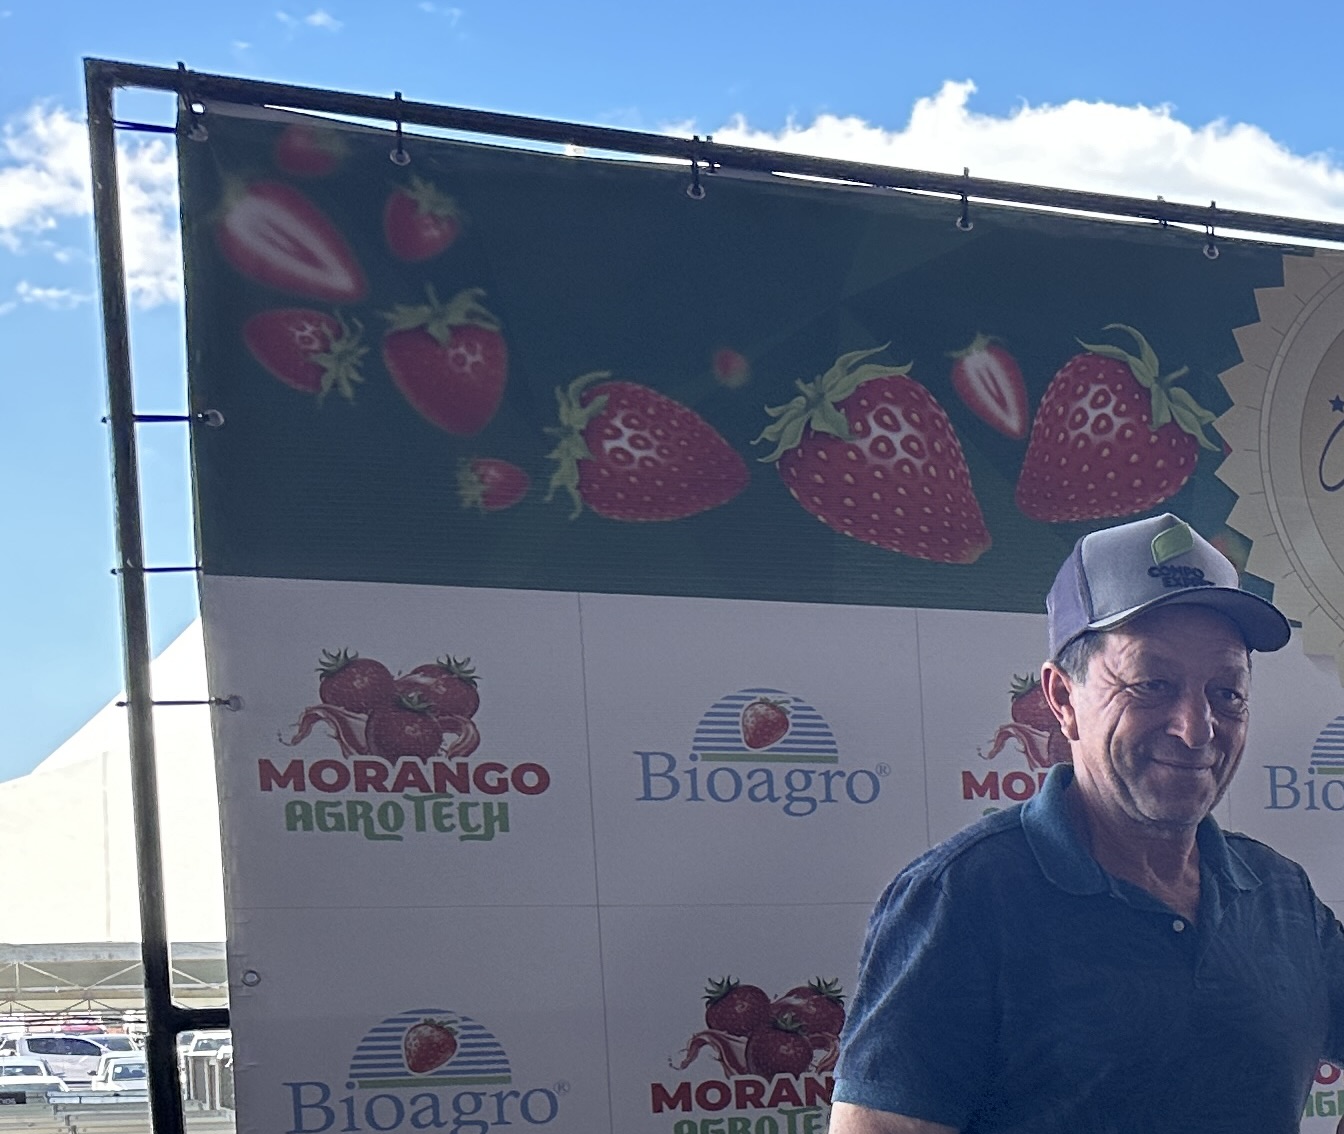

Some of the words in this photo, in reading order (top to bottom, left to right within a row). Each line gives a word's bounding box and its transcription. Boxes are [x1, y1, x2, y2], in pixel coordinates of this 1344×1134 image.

[258, 758, 551, 795] MORANGO
[285, 794, 510, 841] AGROTECH
[651, 1076, 834, 1113] MORAN
